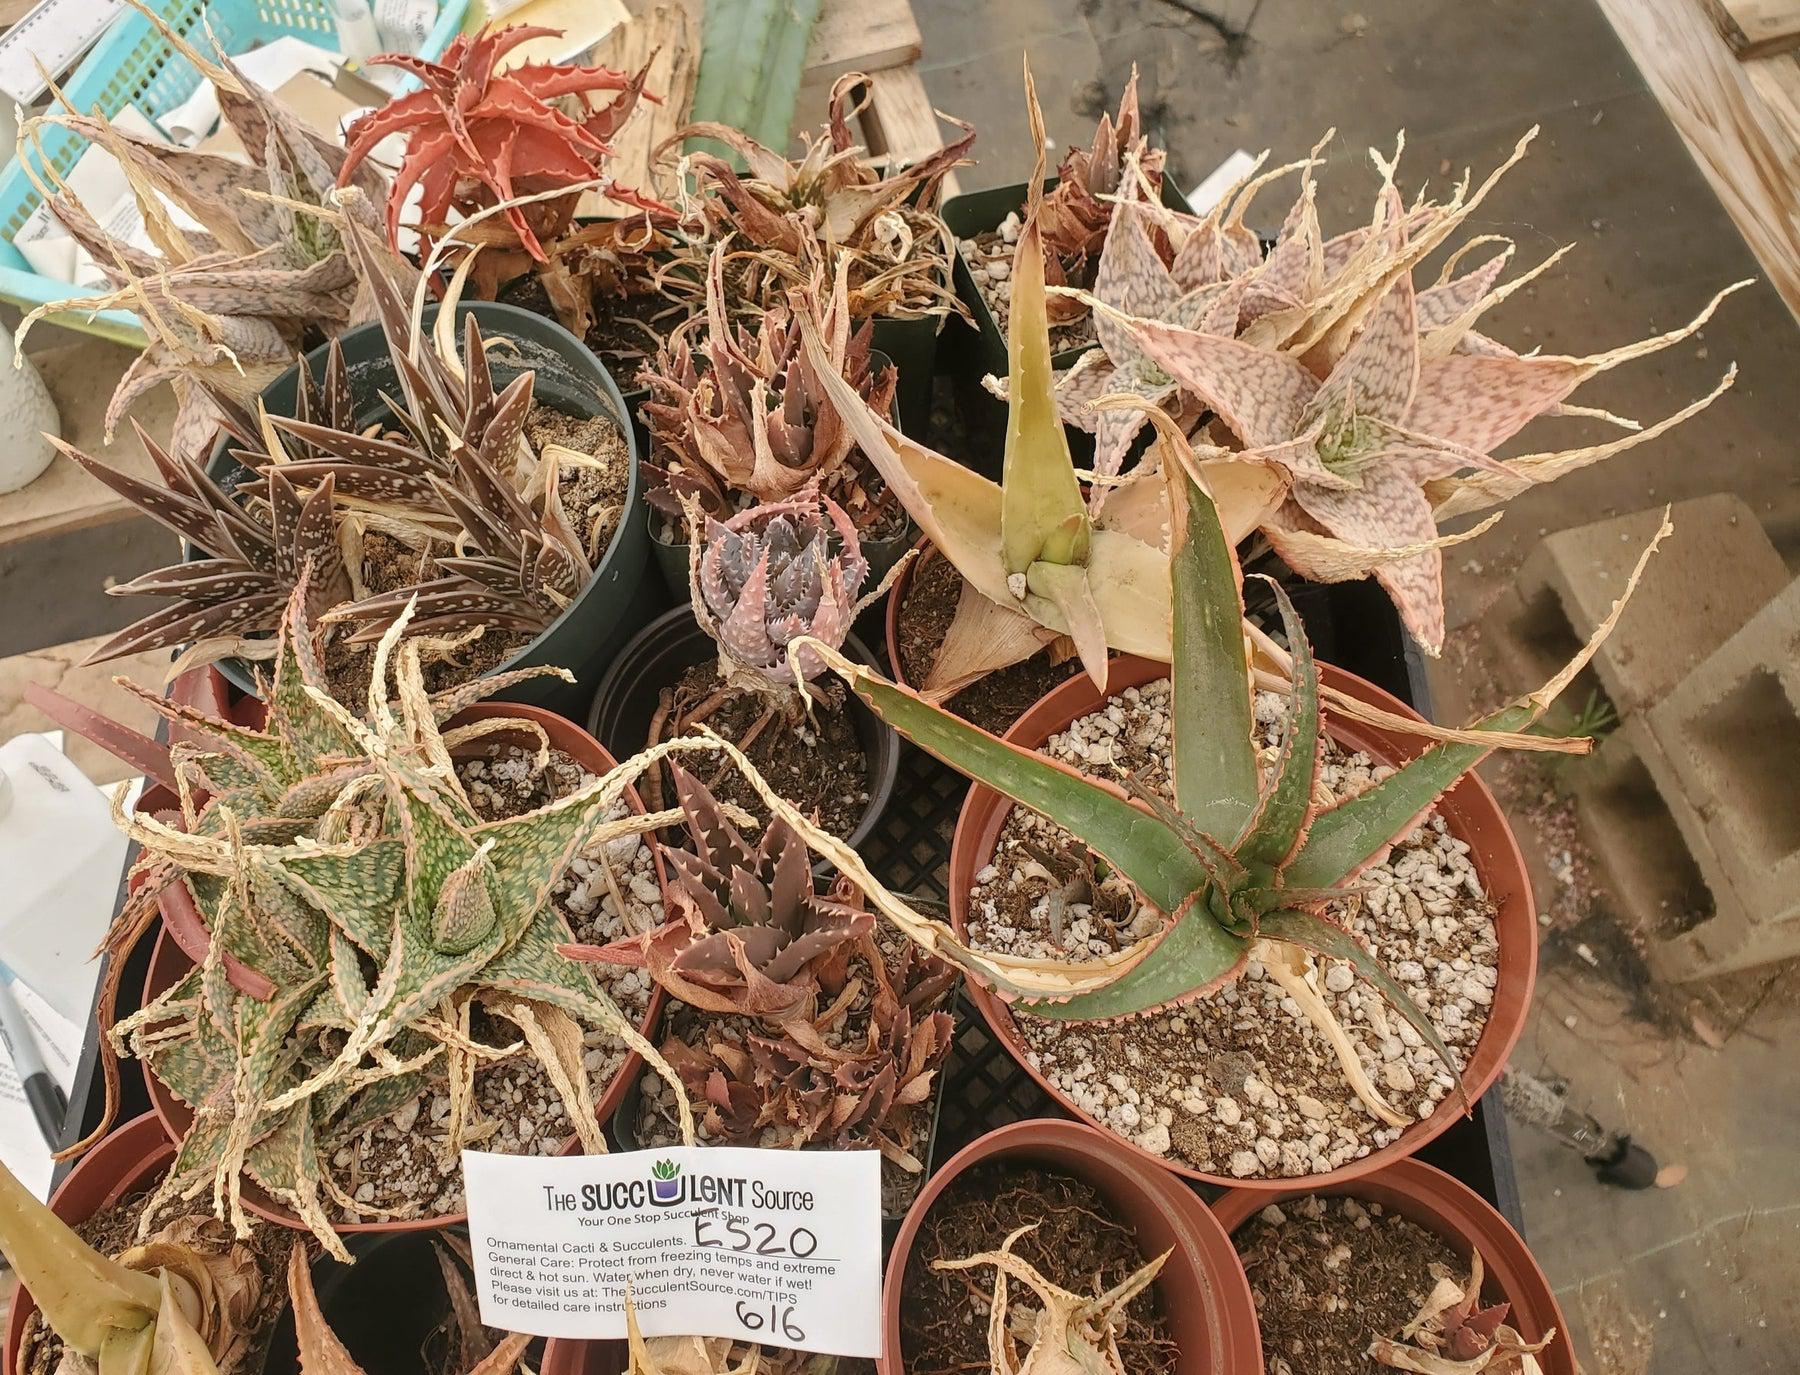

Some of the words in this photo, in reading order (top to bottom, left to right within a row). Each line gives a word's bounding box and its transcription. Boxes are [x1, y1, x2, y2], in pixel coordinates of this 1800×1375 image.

[752, 1180, 814, 1211] Source
[578, 1217, 604, 1226] Your
[608, 1216, 631, 1225] One
[635, 1214, 661, 1223] Stop
[664, 1208, 719, 1220] Succulent
[722, 1211, 749, 1225] Shop
[487, 1237, 558, 1253] Ornamental
[562, 1243, 595, 1253] Cacti
[599, 1243, 608, 1252] &
[613, 1236, 686, 1252] Succulents.
[488, 1252, 536, 1266] General
[540, 1257, 574, 1268] Care:
[579, 1257, 624, 1268] Protect
[628, 1256, 657, 1266] from
[661, 1250, 711, 1263] freezing
[716, 1252, 752, 1268] temps
[756, 1259, 779, 1271] and
[784, 1263, 835, 1275] extreme
[490, 1267, 523, 1280] direct
[526, 1270, 535, 1280] &
[539, 1271, 558, 1282] hot
[563, 1274, 588, 1283] sun.
[593, 1272, 632, 1282] Water
[635, 1269, 669, 1280] when
[674, 1266, 695, 1279] dry,
[700, 1267, 734, 1279] never
[738, 1273, 771, 1286] water
[775, 1277, 782, 1287] if
[786, 1280, 812, 1290] wet!
[492, 1280, 531, 1294] Please
[536, 1286, 560, 1297] visit
[564, 1288, 578, 1297] us
[583, 1288, 598, 1298] at:
[493, 1294, 508, 1304] for
[512, 1297, 559, 1311] detailed
[563, 1302, 590, 1312] care
[736, 1301, 805, 1342] 616
